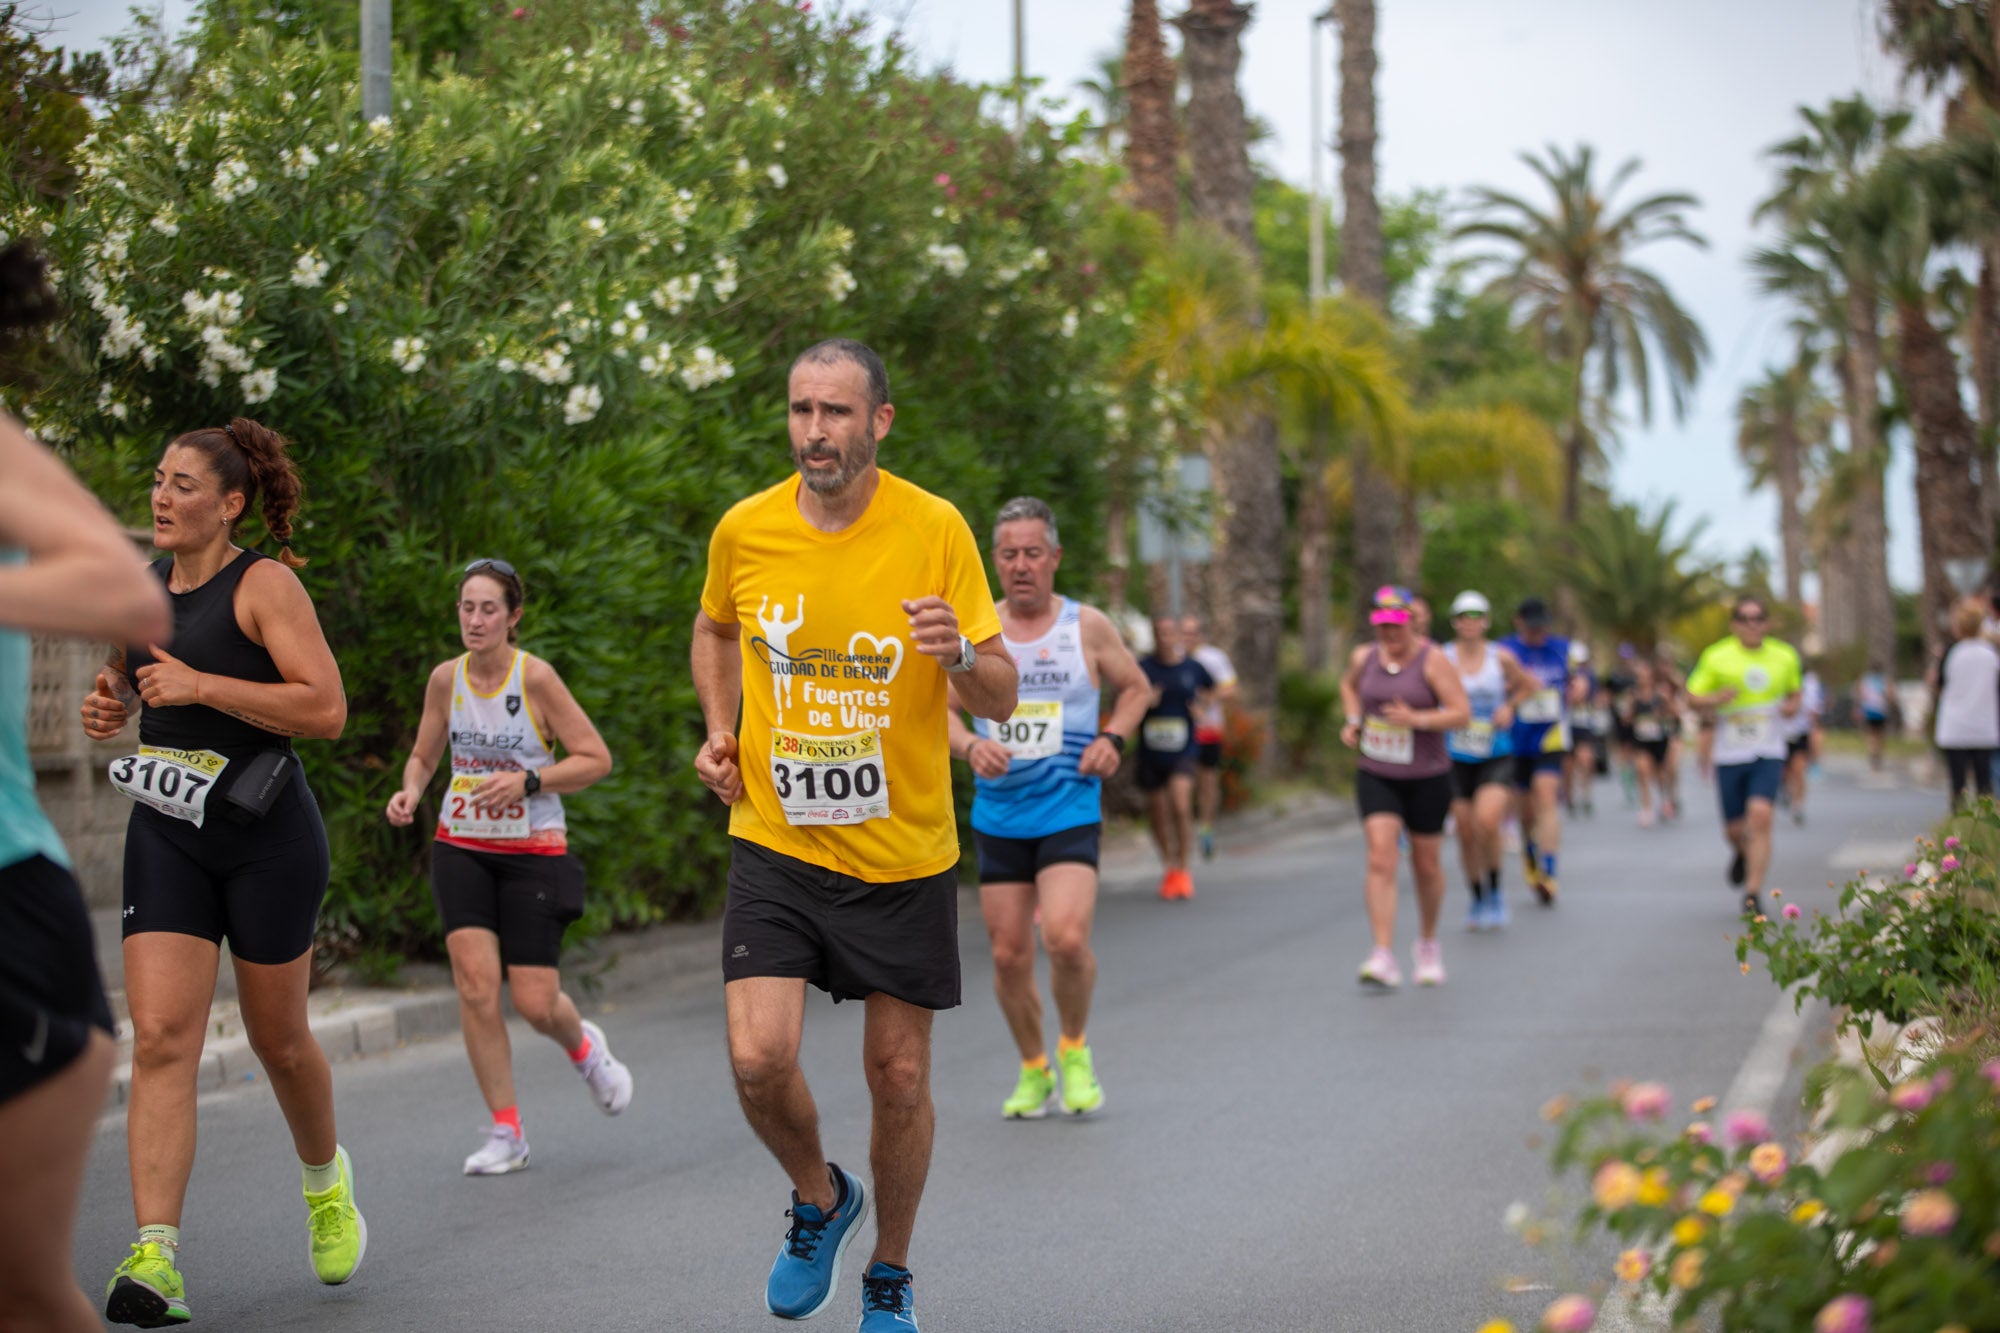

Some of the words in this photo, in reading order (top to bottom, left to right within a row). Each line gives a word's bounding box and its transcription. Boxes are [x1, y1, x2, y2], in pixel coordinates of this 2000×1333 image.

[770, 661, 816, 677] CIUDAD
[821, 664, 839, 678] DE
[844, 665, 889, 680] BERJA
[998, 722, 1048, 742] 907
[782, 736, 798, 753] 38
[798, 743, 856, 758] FONDO
[113, 757, 210, 804] 3107
[774, 763, 880, 800] 3100
